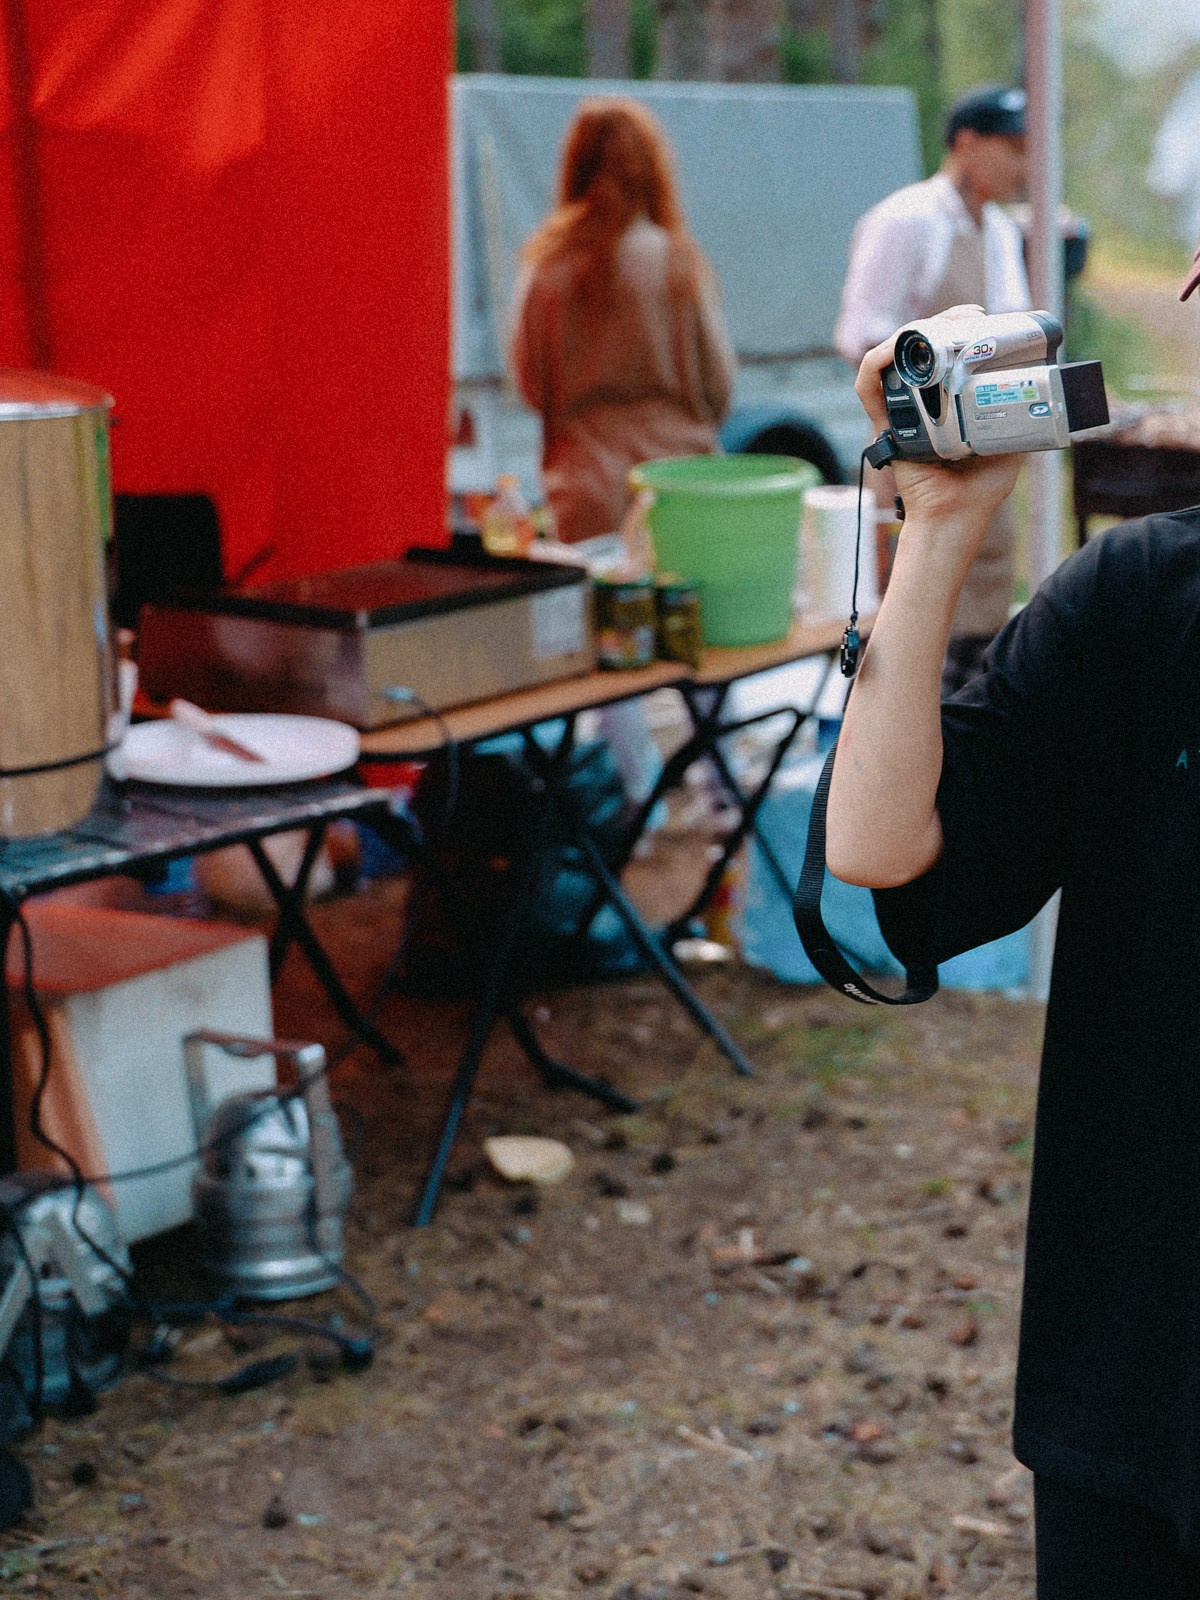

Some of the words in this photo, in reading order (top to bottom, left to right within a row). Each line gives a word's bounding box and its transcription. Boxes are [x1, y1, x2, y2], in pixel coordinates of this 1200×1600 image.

[974, 344, 994, 355] 30x
[975, 410, 1007, 420] Panasonic
[1175, 748, 1189, 769] А
